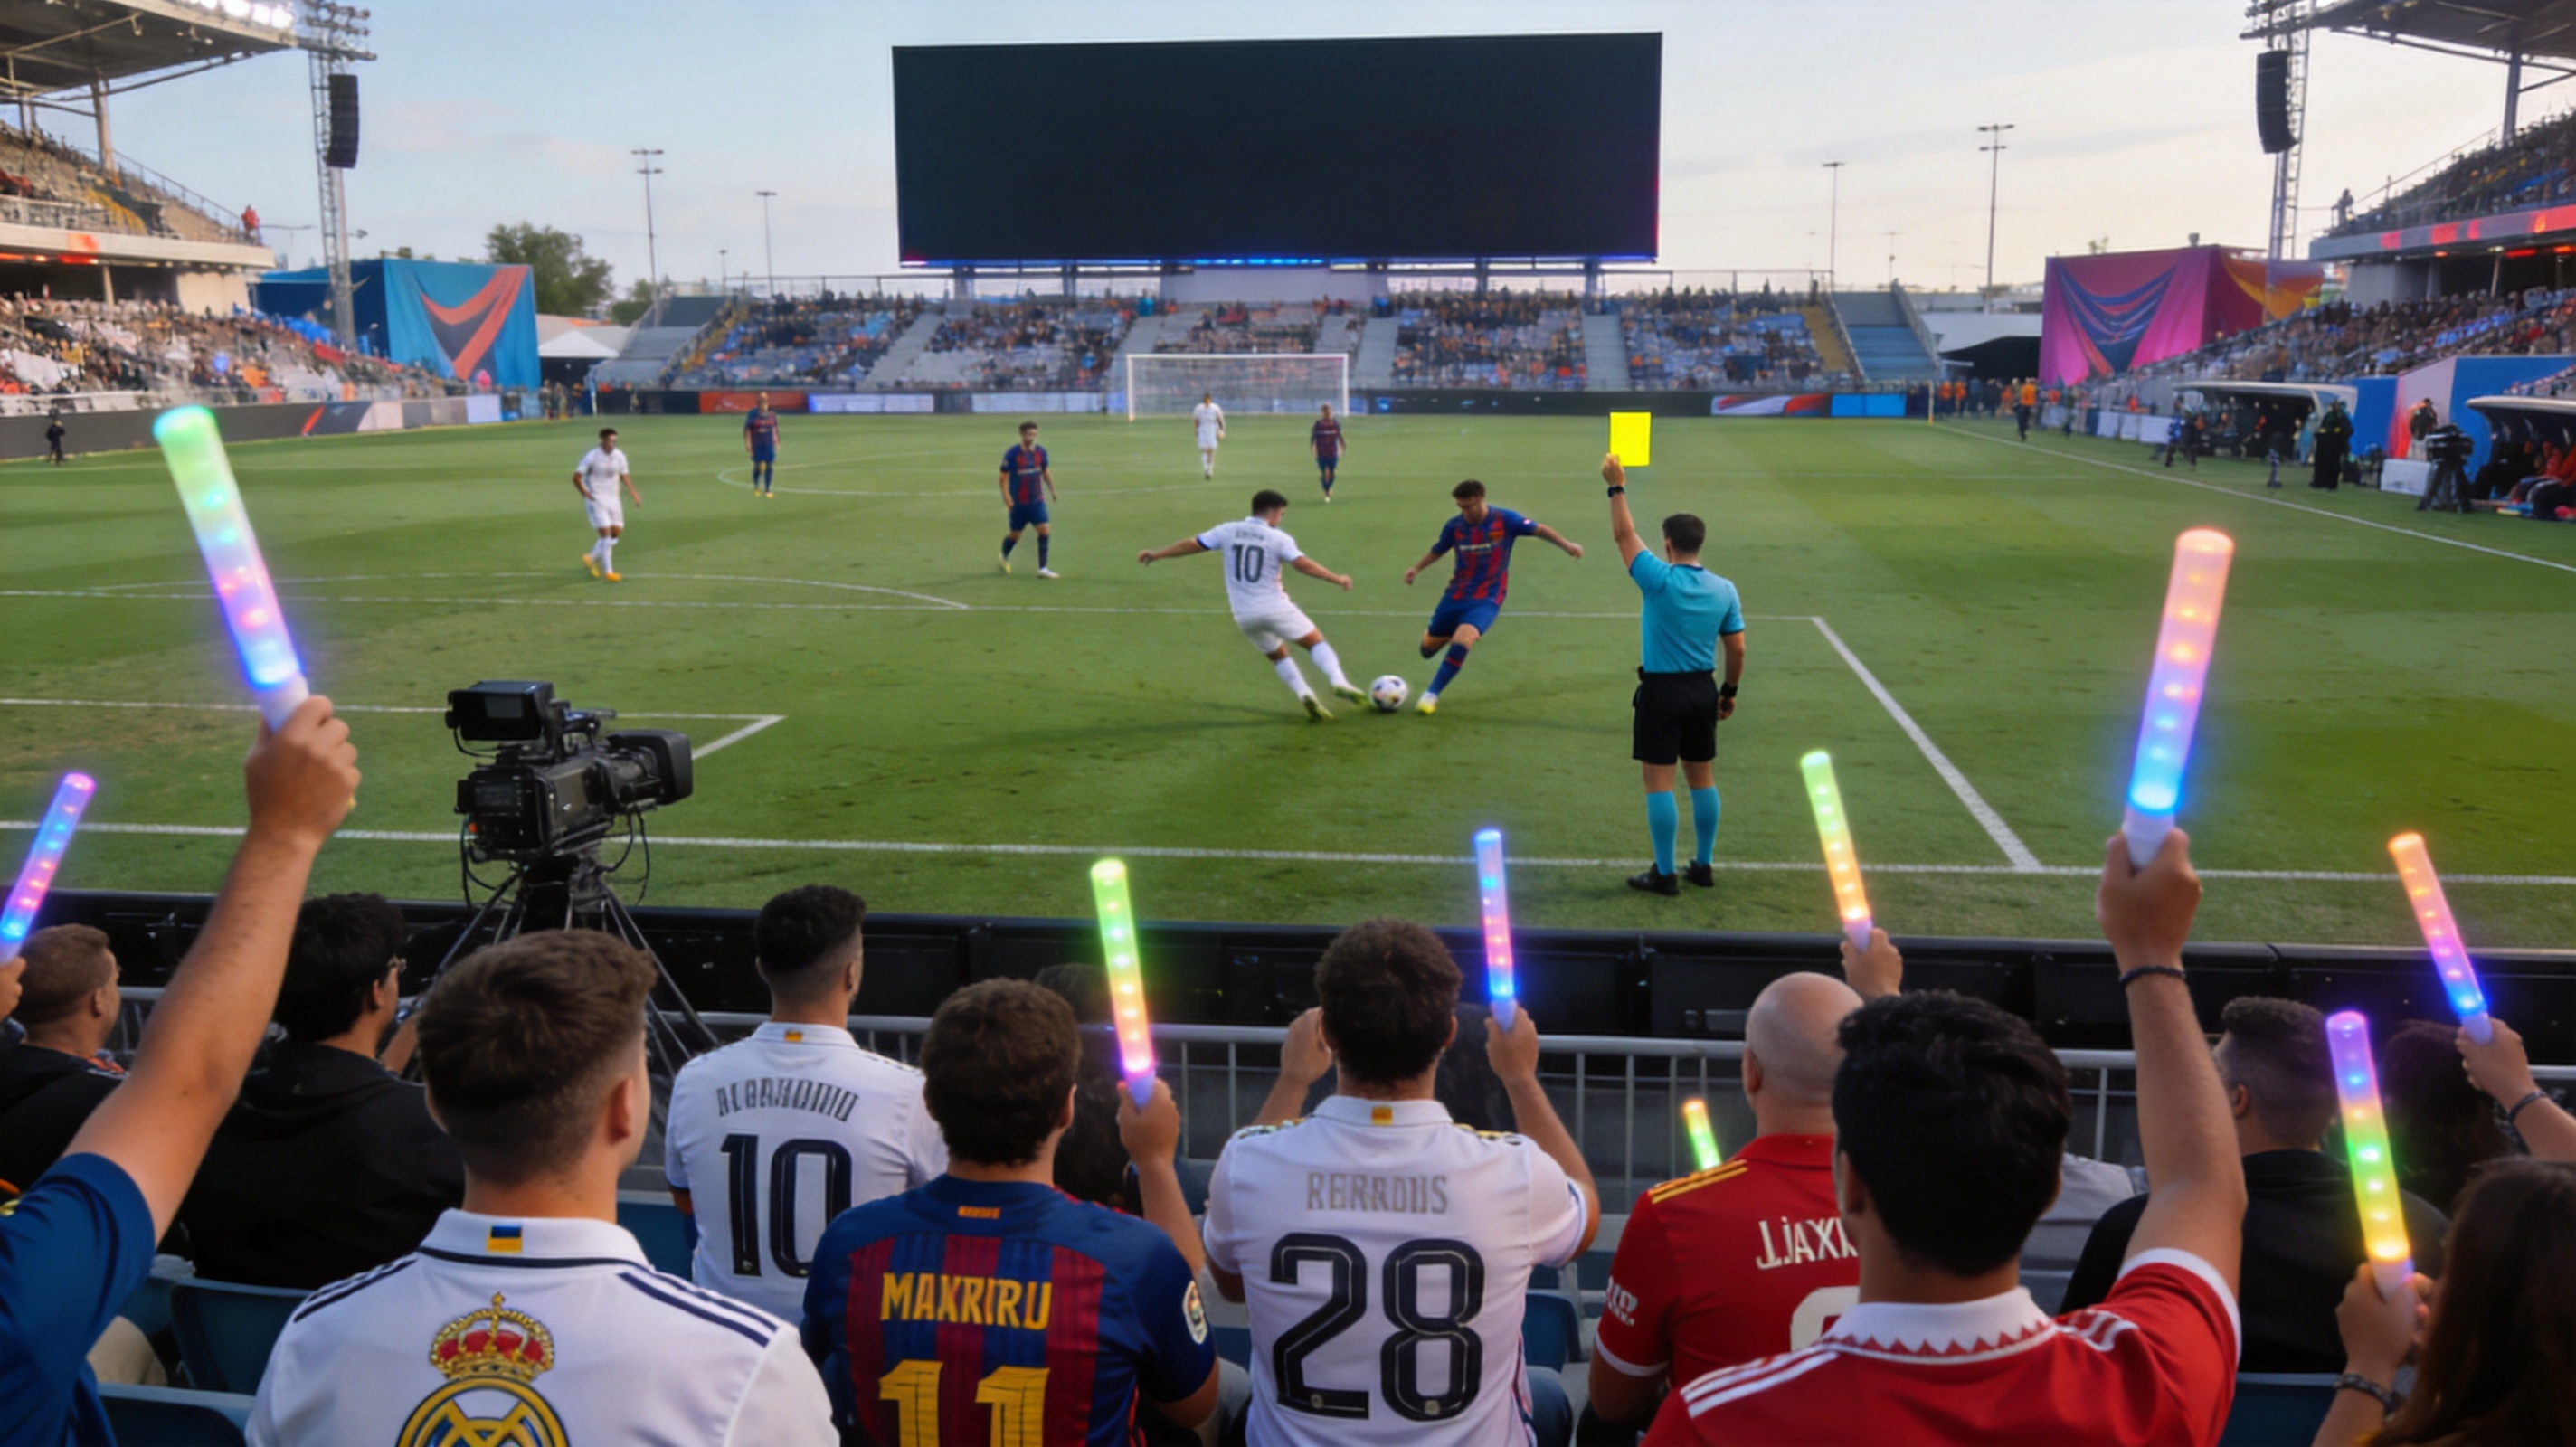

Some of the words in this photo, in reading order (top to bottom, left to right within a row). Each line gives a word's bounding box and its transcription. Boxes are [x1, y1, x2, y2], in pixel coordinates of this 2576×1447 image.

[1232, 544, 1264, 582] 10
[720, 1133, 852, 1278] 10
[1270, 1233, 1484, 1421] 28
[879, 1359, 1050, 1447] 11
